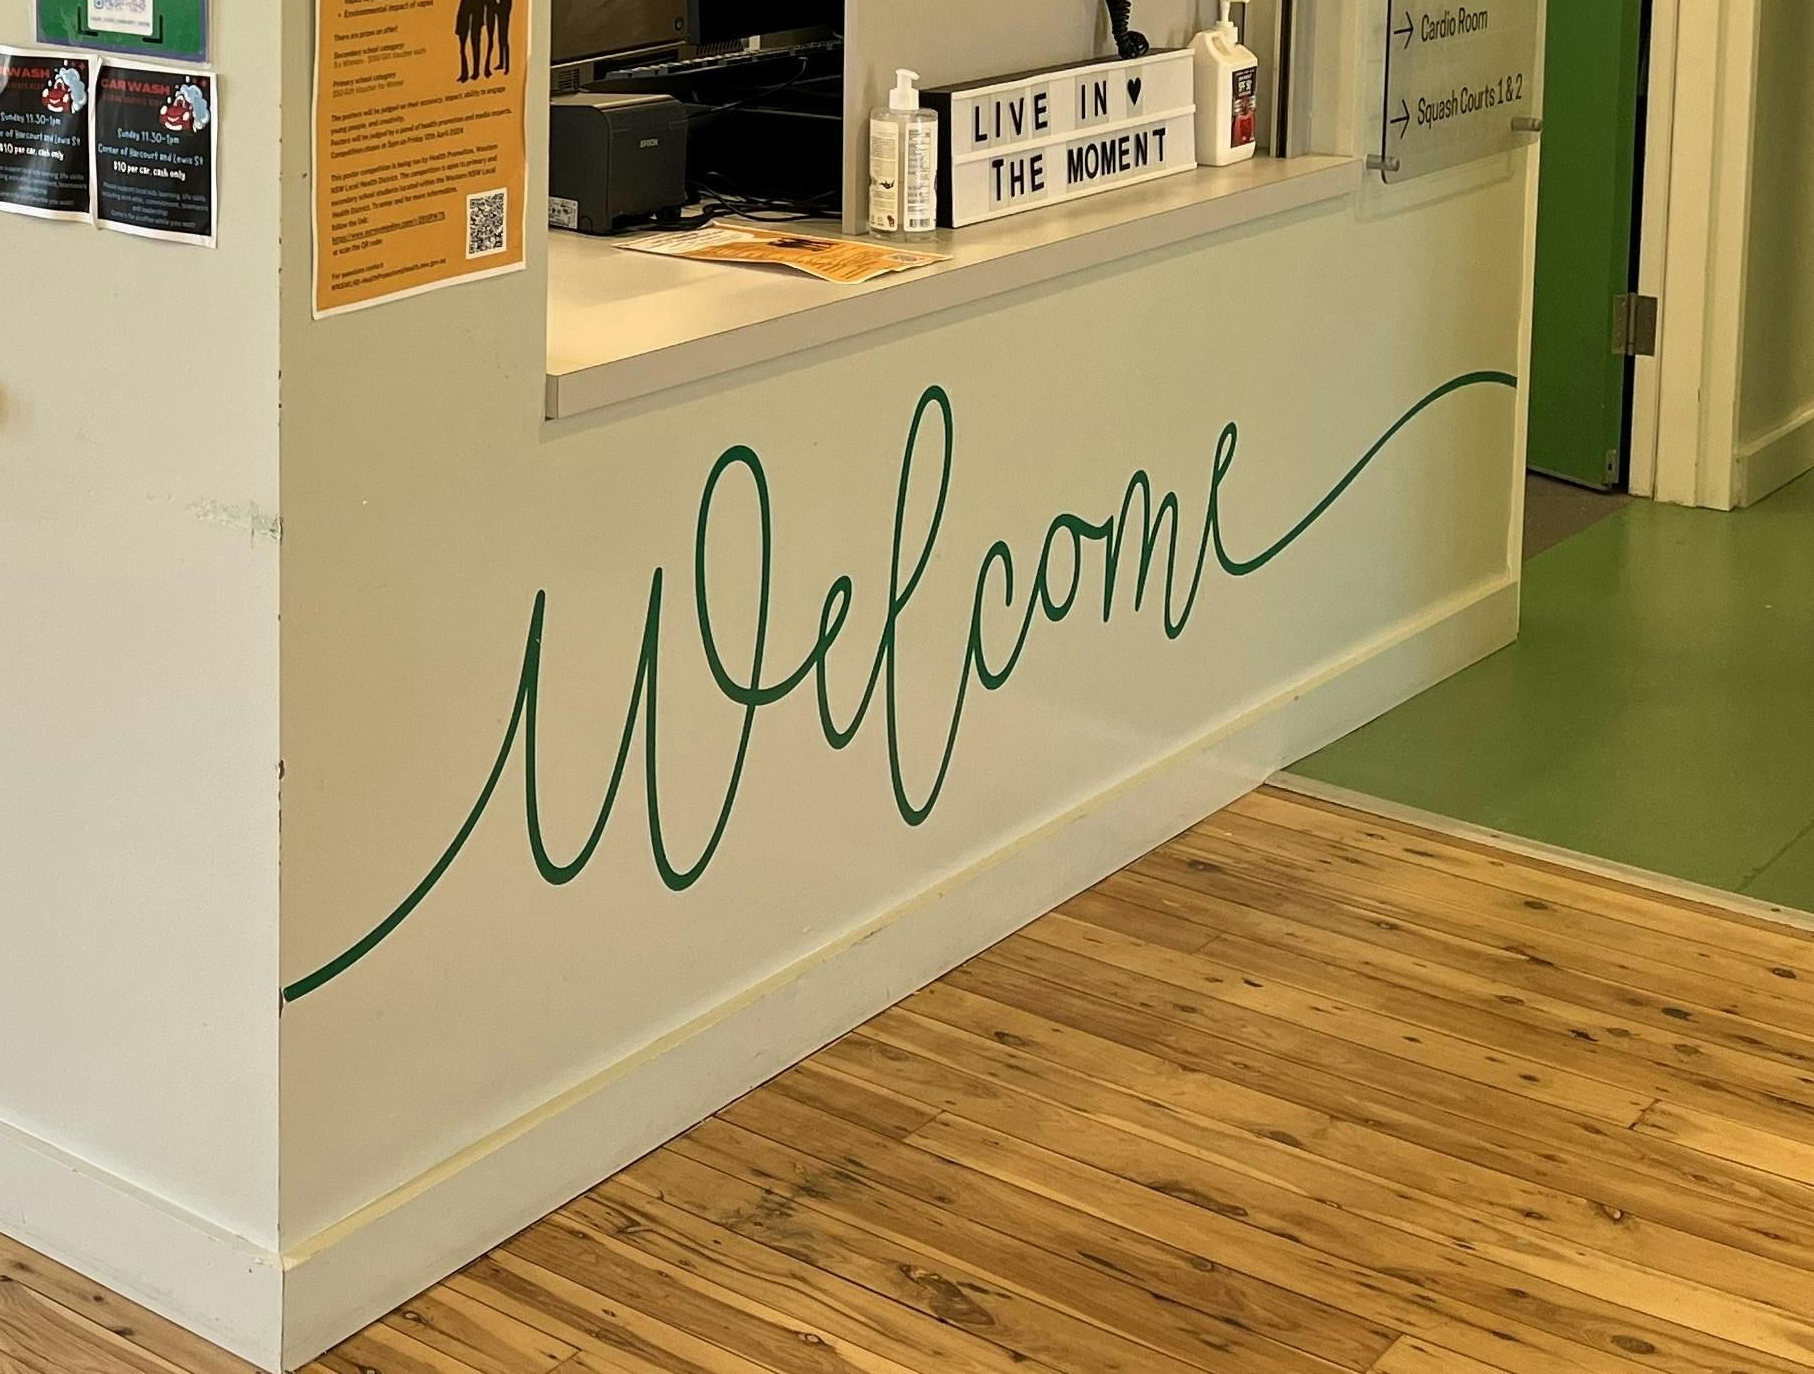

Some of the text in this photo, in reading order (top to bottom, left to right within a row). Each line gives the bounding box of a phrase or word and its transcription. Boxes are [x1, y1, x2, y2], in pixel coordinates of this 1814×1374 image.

[1421, 7, 1488, 43] Cardio Room
[974, 80, 1108, 142] LIVE IN
[1417, 73, 1523, 130] Squash Courts 1 & 2
[117, 128, 140, 142] Sunday
[98, 144, 119, 156] Corner
[120, 146, 128, 157] of
[160, 151, 172, 163] and
[172, 153, 193, 166] Lewis
[194, 155, 204, 167] St
[113, 160, 127, 173] $10
[127, 164, 139, 175] per
[153, 166, 169, 178] cash
[169, 168, 186, 181] only
[991, 154, 1045, 201] THE
[1068, 127, 1166, 184] MOMENT
